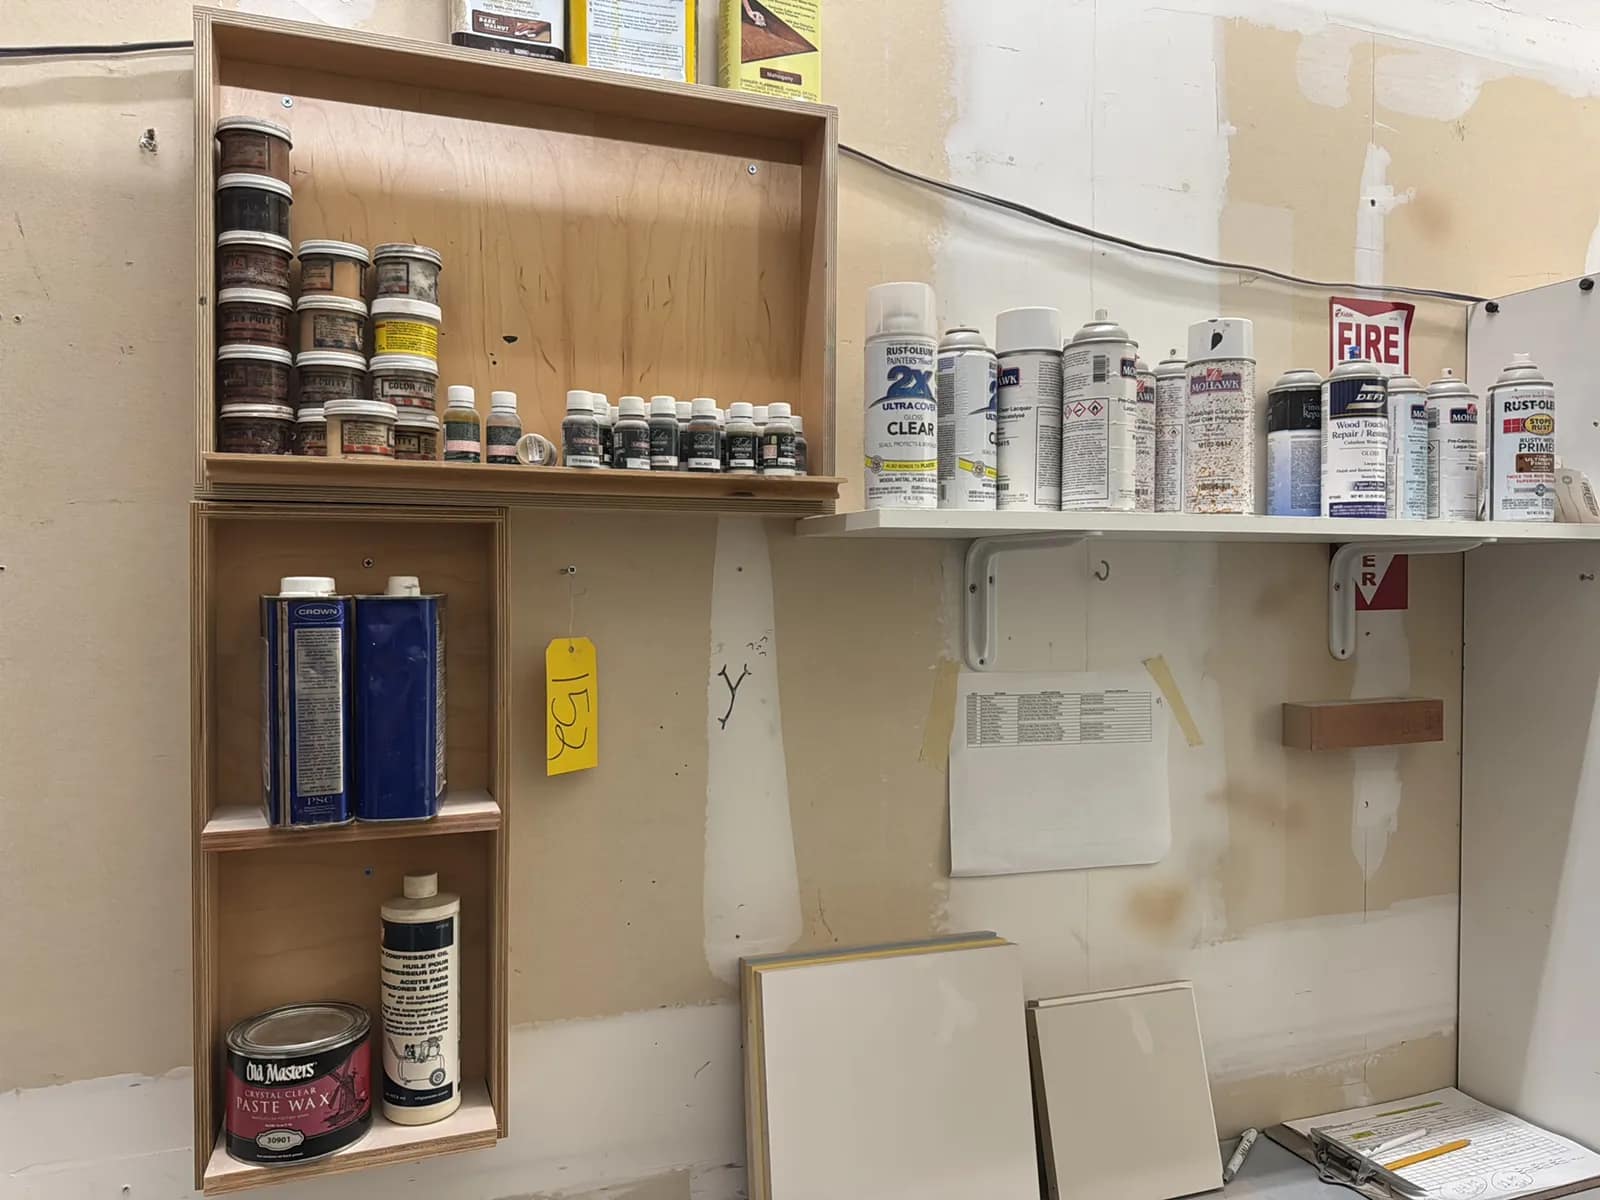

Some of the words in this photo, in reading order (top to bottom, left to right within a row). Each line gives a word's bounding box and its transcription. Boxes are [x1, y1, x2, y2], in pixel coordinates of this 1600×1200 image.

[484, 23, 509, 32] WALNUT
[766, 71, 794, 82] Mahogany
[1338, 322, 1399, 364] FIRE
[388, 380, 417, 391] COLOR
[886, 365, 933, 399] 2X
[1192, 379, 1240, 392] MOHAWK
[882, 402, 914, 411] ULTRA
[887, 421, 934, 437] CLEAR
[1336, 420, 1360, 429] Wood
[1332, 430, 1359, 440] Repair
[298, 607, 338, 616] CROWN
[385, 951, 436, 960] COMPRESSOR
[428, 958, 448, 969] POUR
[428, 965, 448, 976] D'AIR
[429, 974, 448, 983] PARA
[432, 980, 448, 990] AIRE
[415, 990, 448, 1000] lubricated
[428, 1026, 448, 1035] aceite
[246, 1061, 264, 1081] Old
[264, 1061, 315, 1085] Masters
[245, 1089, 281, 1099] CRYSTAL
[285, 1087, 317, 1098] CLEAR
[236, 1096, 280, 1113] PASTE
[288, 1092, 330, 1112] WAX
[267, 1136, 291, 1144] 30901
